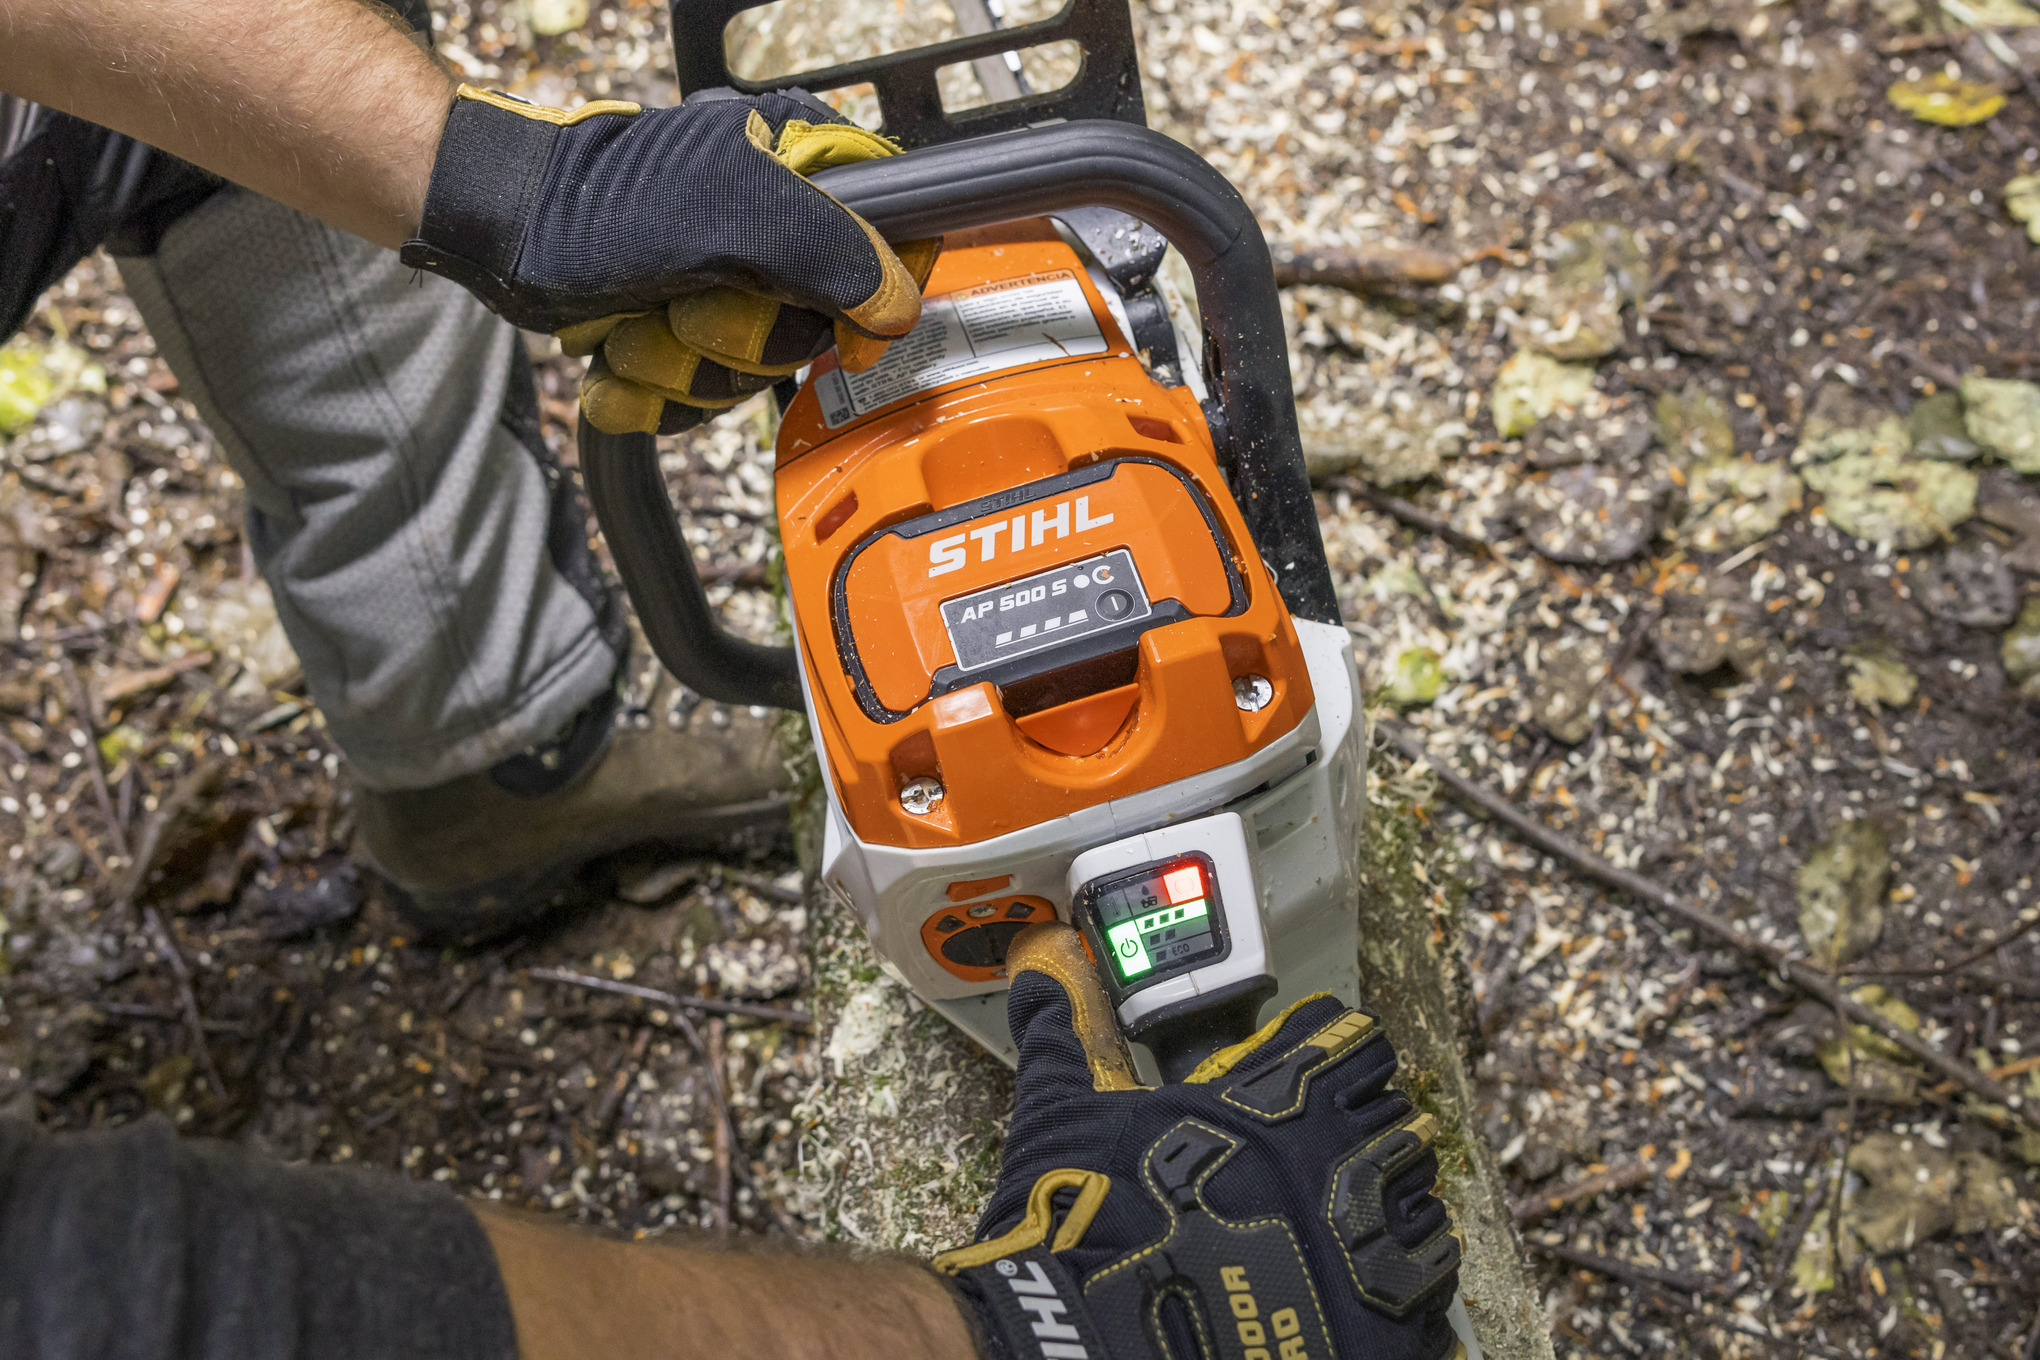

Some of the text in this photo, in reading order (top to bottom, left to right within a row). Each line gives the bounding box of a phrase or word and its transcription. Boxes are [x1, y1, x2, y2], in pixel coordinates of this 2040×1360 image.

[971, 270, 1070, 296] ADVERTENCIA
[980, 488, 1037, 512] STIHL
[928, 496, 1114, 578] STIHL
[961, 579, 1067, 623] AP 500 S
[1172, 943, 1190, 956] ECO
